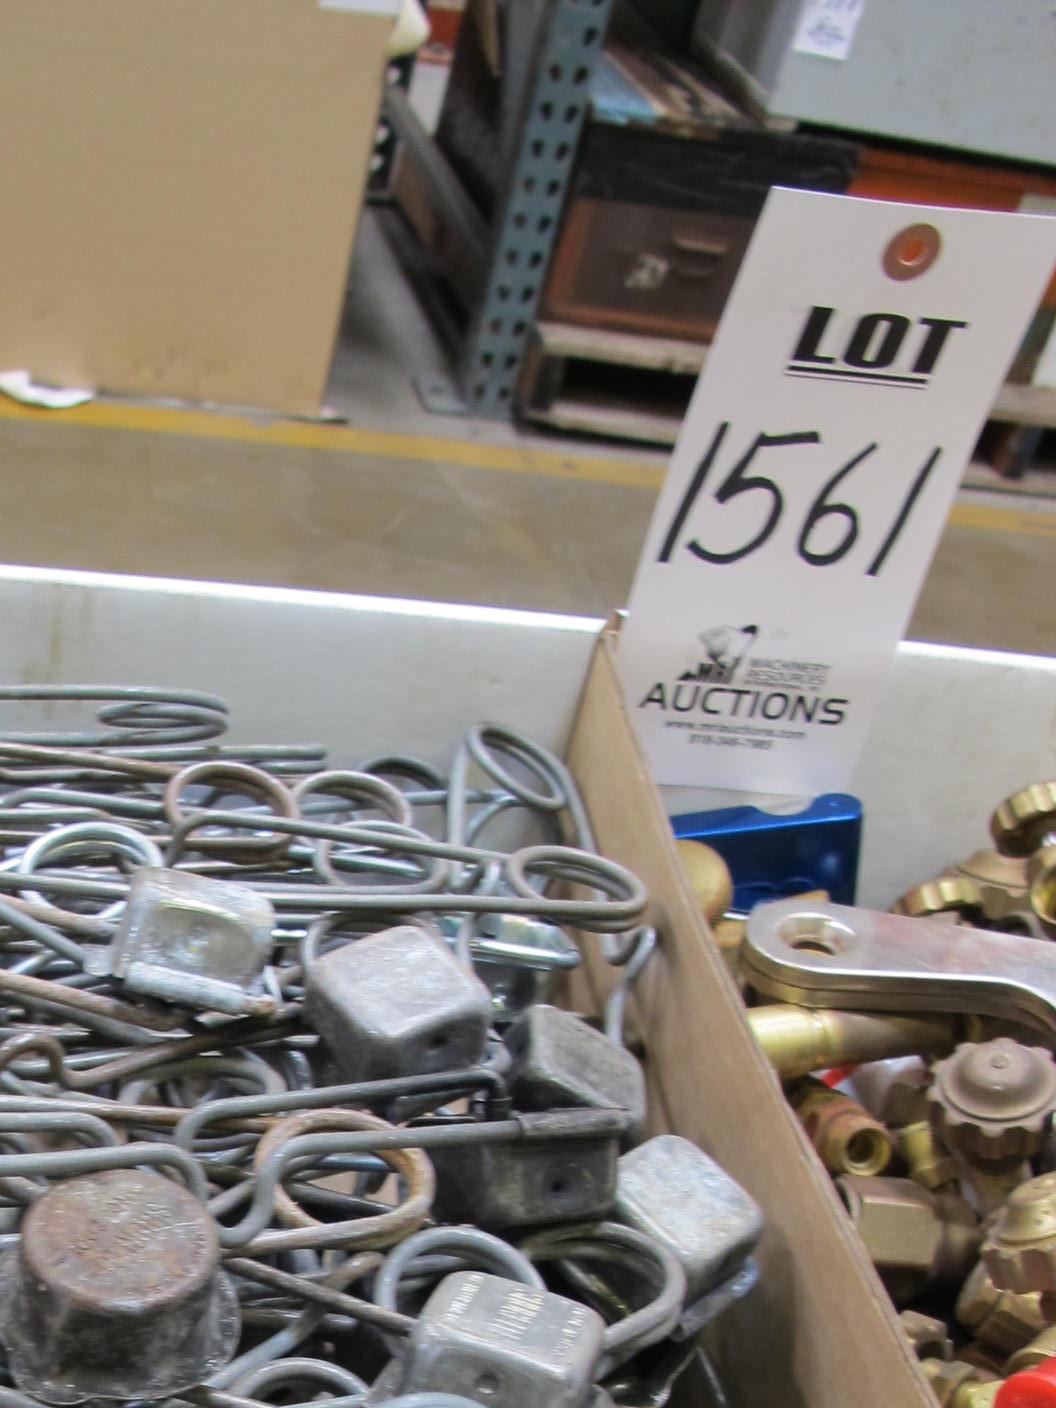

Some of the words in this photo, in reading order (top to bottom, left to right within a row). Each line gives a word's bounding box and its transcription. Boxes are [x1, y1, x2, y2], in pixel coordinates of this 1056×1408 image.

[792, 306, 968, 374] LOT
[657, 421, 942, 576] 1561
[638, 682, 851, 725] AUCTIONS
